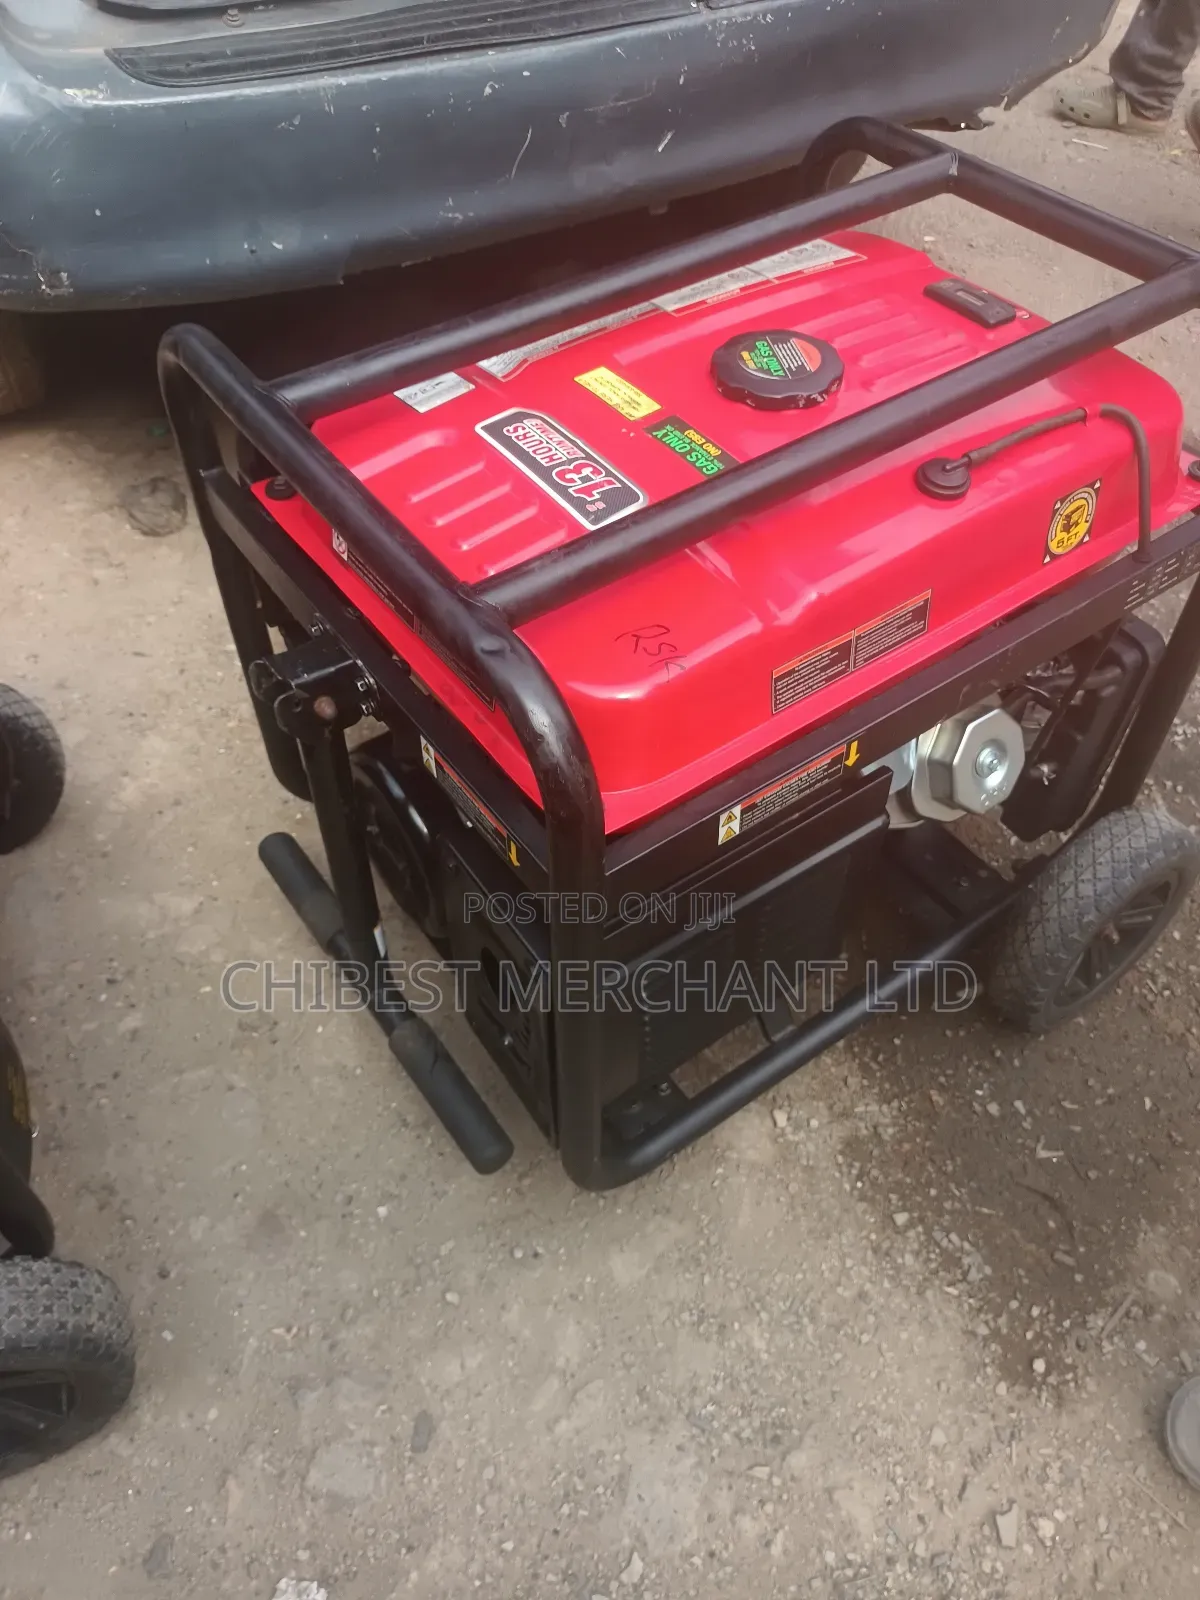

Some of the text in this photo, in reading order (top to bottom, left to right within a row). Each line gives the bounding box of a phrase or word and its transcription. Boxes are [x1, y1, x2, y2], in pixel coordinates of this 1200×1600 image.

[755, 340, 786, 377] GAS ONLY
[652, 428, 691, 457] ONLY
[502, 422, 621, 502] 13 HOURS
[685, 450, 718, 476] GAS
[1055, 538, 1065, 549] 5
